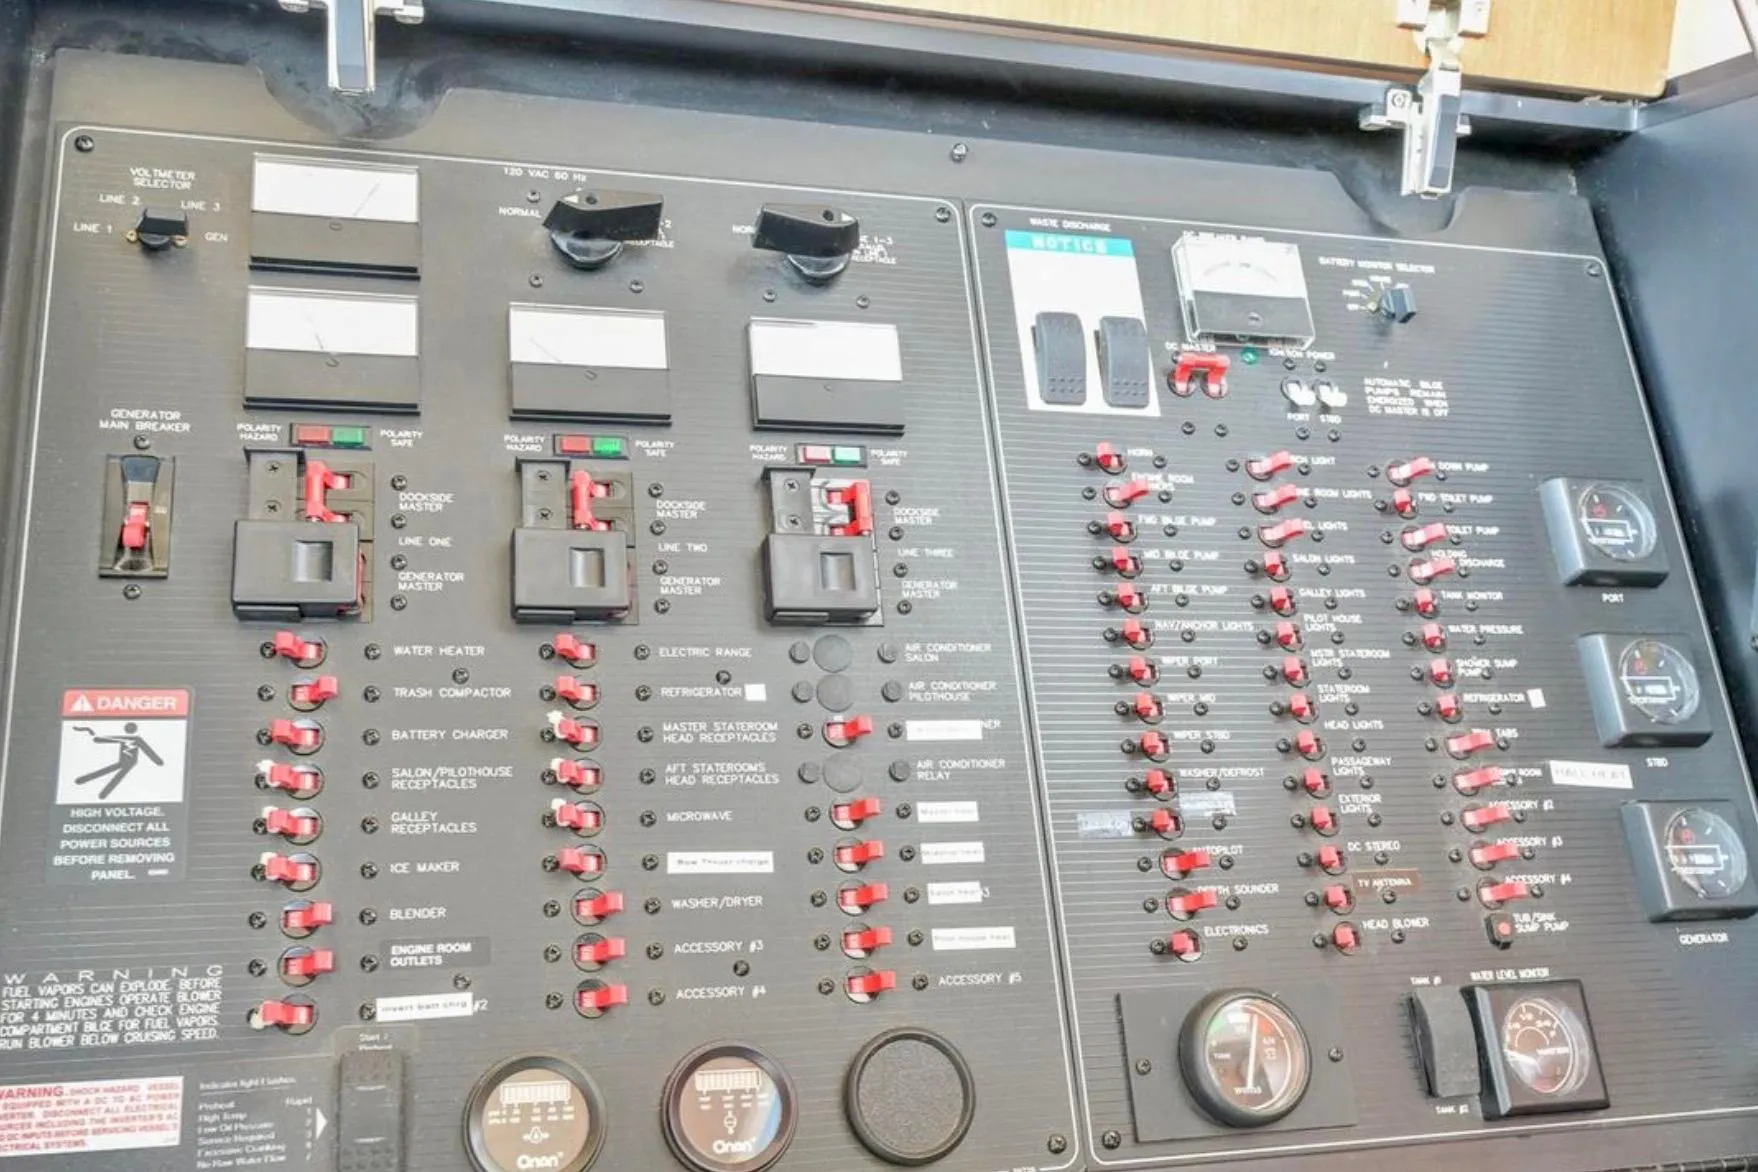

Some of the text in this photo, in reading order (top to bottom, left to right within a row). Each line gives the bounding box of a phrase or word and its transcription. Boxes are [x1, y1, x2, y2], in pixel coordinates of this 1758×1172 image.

[130, 167, 195, 180] VOLTMETER
[504, 168, 523, 177] 120
[528, 170, 549, 179] VAC
[133, 178, 192, 189] SELECTOR
[100, 193, 141, 205] LINE 2
[181, 200, 221, 212] LINE 3
[499, 206, 542, 218] NORMAL
[74, 222, 112, 234] LINE 1
[204, 232, 228, 242] GEN
[1031, 235, 1108, 254] NOTICE
[110, 408, 181, 421] GENERATOR
[100, 420, 191, 433] MAIN BREAKER
[236, 422, 282, 434] POLARITY
[380, 429, 423, 440] POLARITY
[504, 434, 544, 444] POLARITY
[636, 439, 674, 449] POLARITY
[400, 492, 454, 503] DOCKSIDE
[400, 502, 443, 512] MASTER
[656, 500, 706, 512] DOCKSIDE
[656, 510, 698, 520] MASTER
[399, 536, 452, 547] LINE ONE
[658, 542, 708, 552] LINE TWO
[898, 548, 921, 556] LINE
[398, 572, 465, 582] GENERATOR
[660, 576, 721, 586] GENERATOR
[398, 582, 444, 591] MASTER
[660, 586, 702, 596] MASTER
[394, 646, 486, 656] WATER HEATER
[659, 648, 753, 658] ELECTRIC RANGE
[906, 643, 992, 652] AIR CONDITIONER
[904, 653, 940, 662] SALON
[1340, 649, 1390, 658] STATEROOM
[908, 681, 998, 691] AIR CONDITIONER
[1318, 684, 1370, 693] STATEROOM
[394, 687, 511, 698] TRASH COMPACTOR
[661, 688, 743, 697] REFRIGERATOR
[909, 692, 972, 702] PILOTHOUSE
[97, 696, 176, 711] DANGER
[664, 722, 778, 732] MASTER STATEROOM
[1324, 720, 1384, 730] HEAD LIGHTS
[392, 730, 509, 740] BATTERY CHARGER
[664, 733, 777, 743] HEAD RECEPTACLES
[916, 758, 1006, 769] AIR CONDITIONER
[1331, 757, 1392, 766] PASSAGEWAY
[392, 766, 513, 780] SALON/PILOTHOUSE
[666, 763, 766, 773] AFT STATEROOMS
[665, 775, 780, 786] HEAD RECEPTACLES
[917, 770, 950, 780] RELAY
[392, 778, 478, 790] RECEPTACLES
[1338, 794, 1382, 804] EXTERIOR
[70, 808, 102, 818] HIGH
[392, 810, 438, 822] GALLEY
[666, 812, 733, 822] MICROWAVE
[63, 822, 171, 834] DISCONNECT ALL
[392, 822, 478, 834] RECEPTACLES
[61, 836, 172, 849] POWER SOURCES
[1348, 840, 1400, 852] DC STEREO
[53, 853, 176, 866] BEFORE REMOVING
[390, 861, 460, 874] ICE MAKER
[92, 870, 136, 880] PANEL.
[1234, 883, 1279, 895] SOUNDER
[672, 896, 763, 910] WASHER/DRYER
[390, 906, 447, 920] BLENDER
[1362, 916, 1430, 929] HEAD BLOWER
[1204, 924, 1270, 936] ELECTRONICS
[391, 942, 472, 955] ENGINE ROOM
[674, 940, 764, 954] ACCESSORY #3
[390, 954, 443, 967] OUTLETS
[938, 973, 1002, 986] ACCESSORY
[2, 978, 221, 998] FUEL VAPORS CAN EXPLODE BEFORE
[676, 986, 766, 1000] ACCESSORY #4
[2, 991, 222, 1010] STARTING ENGINES OPERATE BLOWER
[1, 1003, 220, 1024] FOR 4 MINUTES AND CHECK ENGINE
[84, 1020, 113, 1033] BILGE
[118, 1019, 140, 1030] FOR
[144, 1018, 170, 1030] FUEL
[28, 1036, 74, 1048] BLOWER
[80, 1034, 120, 1046] BELOW
[124, 1030, 176, 1044] CRUISING
[713, 1139, 750, 1153] Onan
[516, 1154, 556, 1168] Onan
